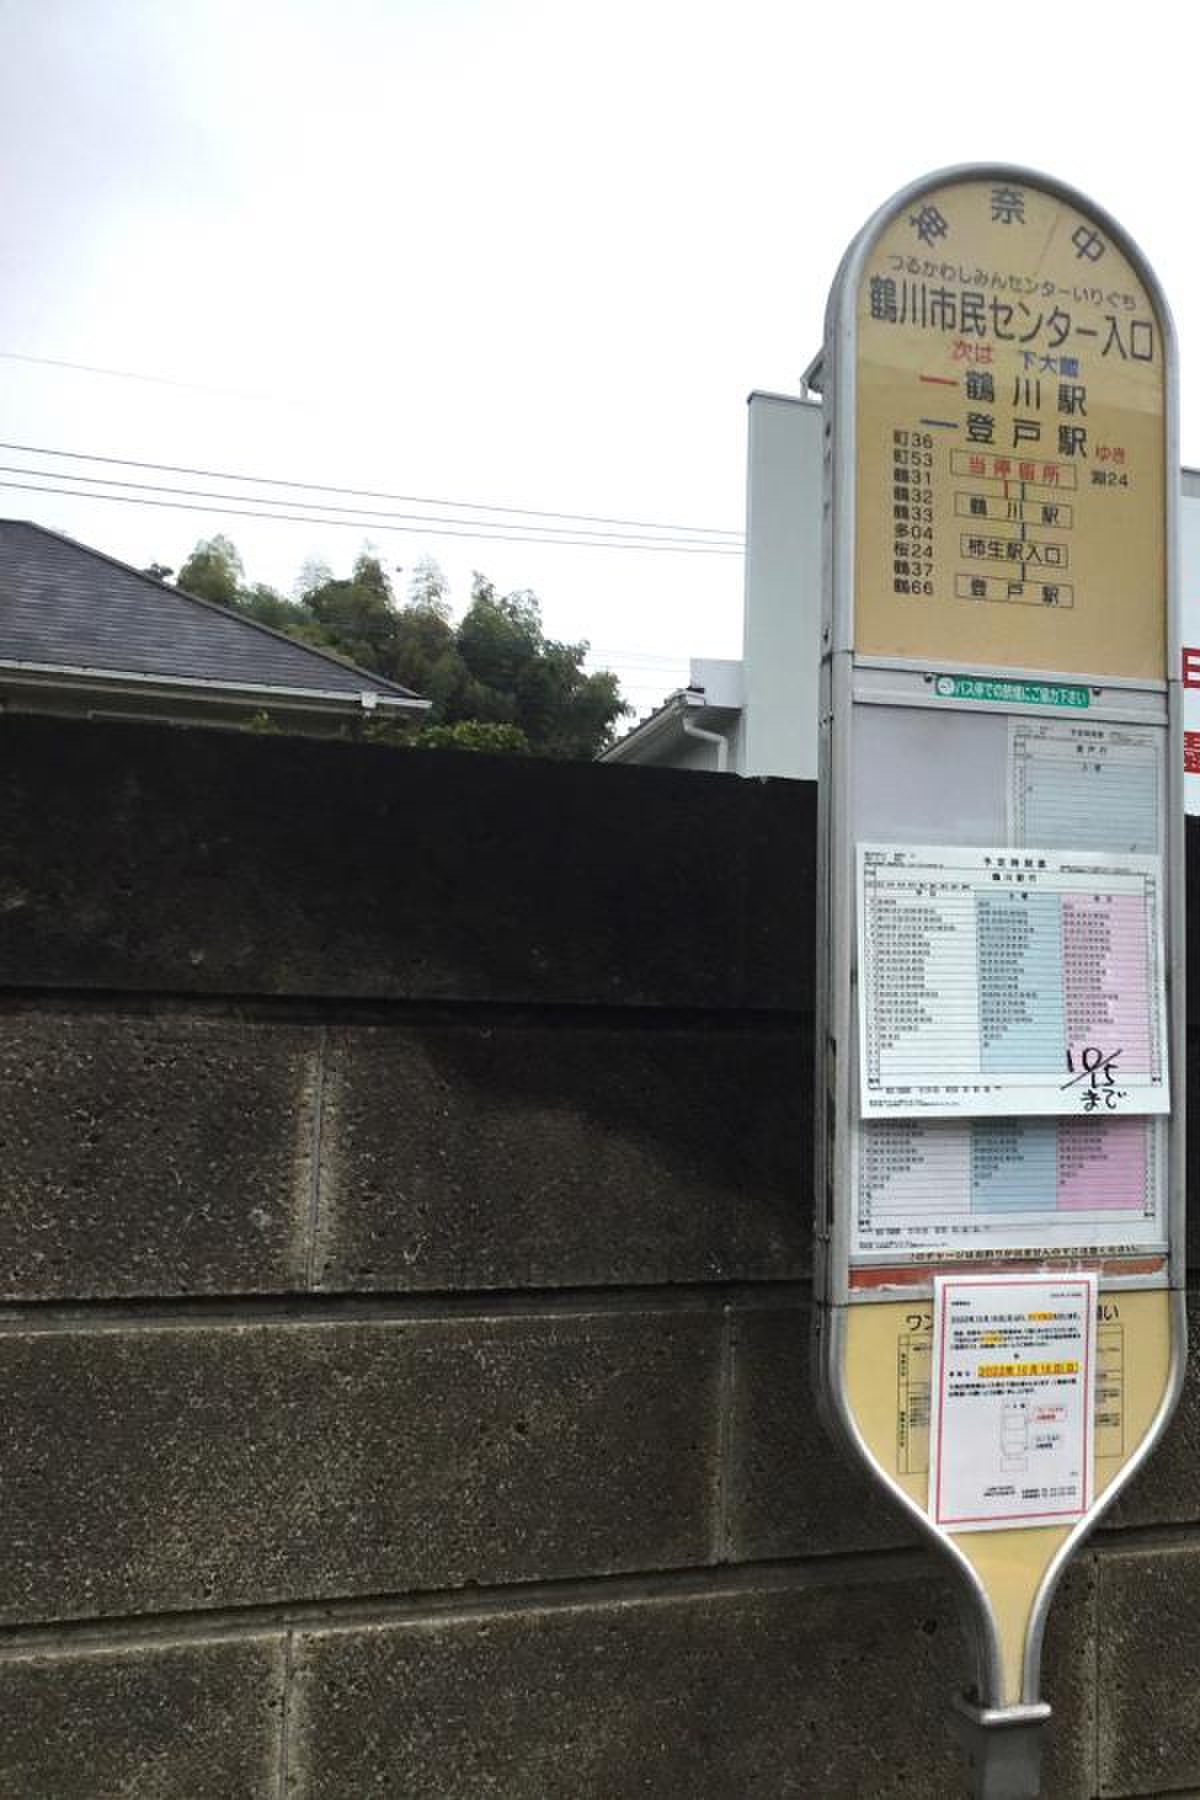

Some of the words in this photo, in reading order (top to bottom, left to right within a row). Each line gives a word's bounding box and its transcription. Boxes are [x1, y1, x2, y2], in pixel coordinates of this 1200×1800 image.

[869, 275, 1153, 362] 鶴川市民センター入口
[952, 341, 994, 364] 次は
[965, 371, 1086, 416] 鶴川駅
[966, 412, 1087, 457] 登戸駅
[1081, 1088, 1127, 1112] まで
